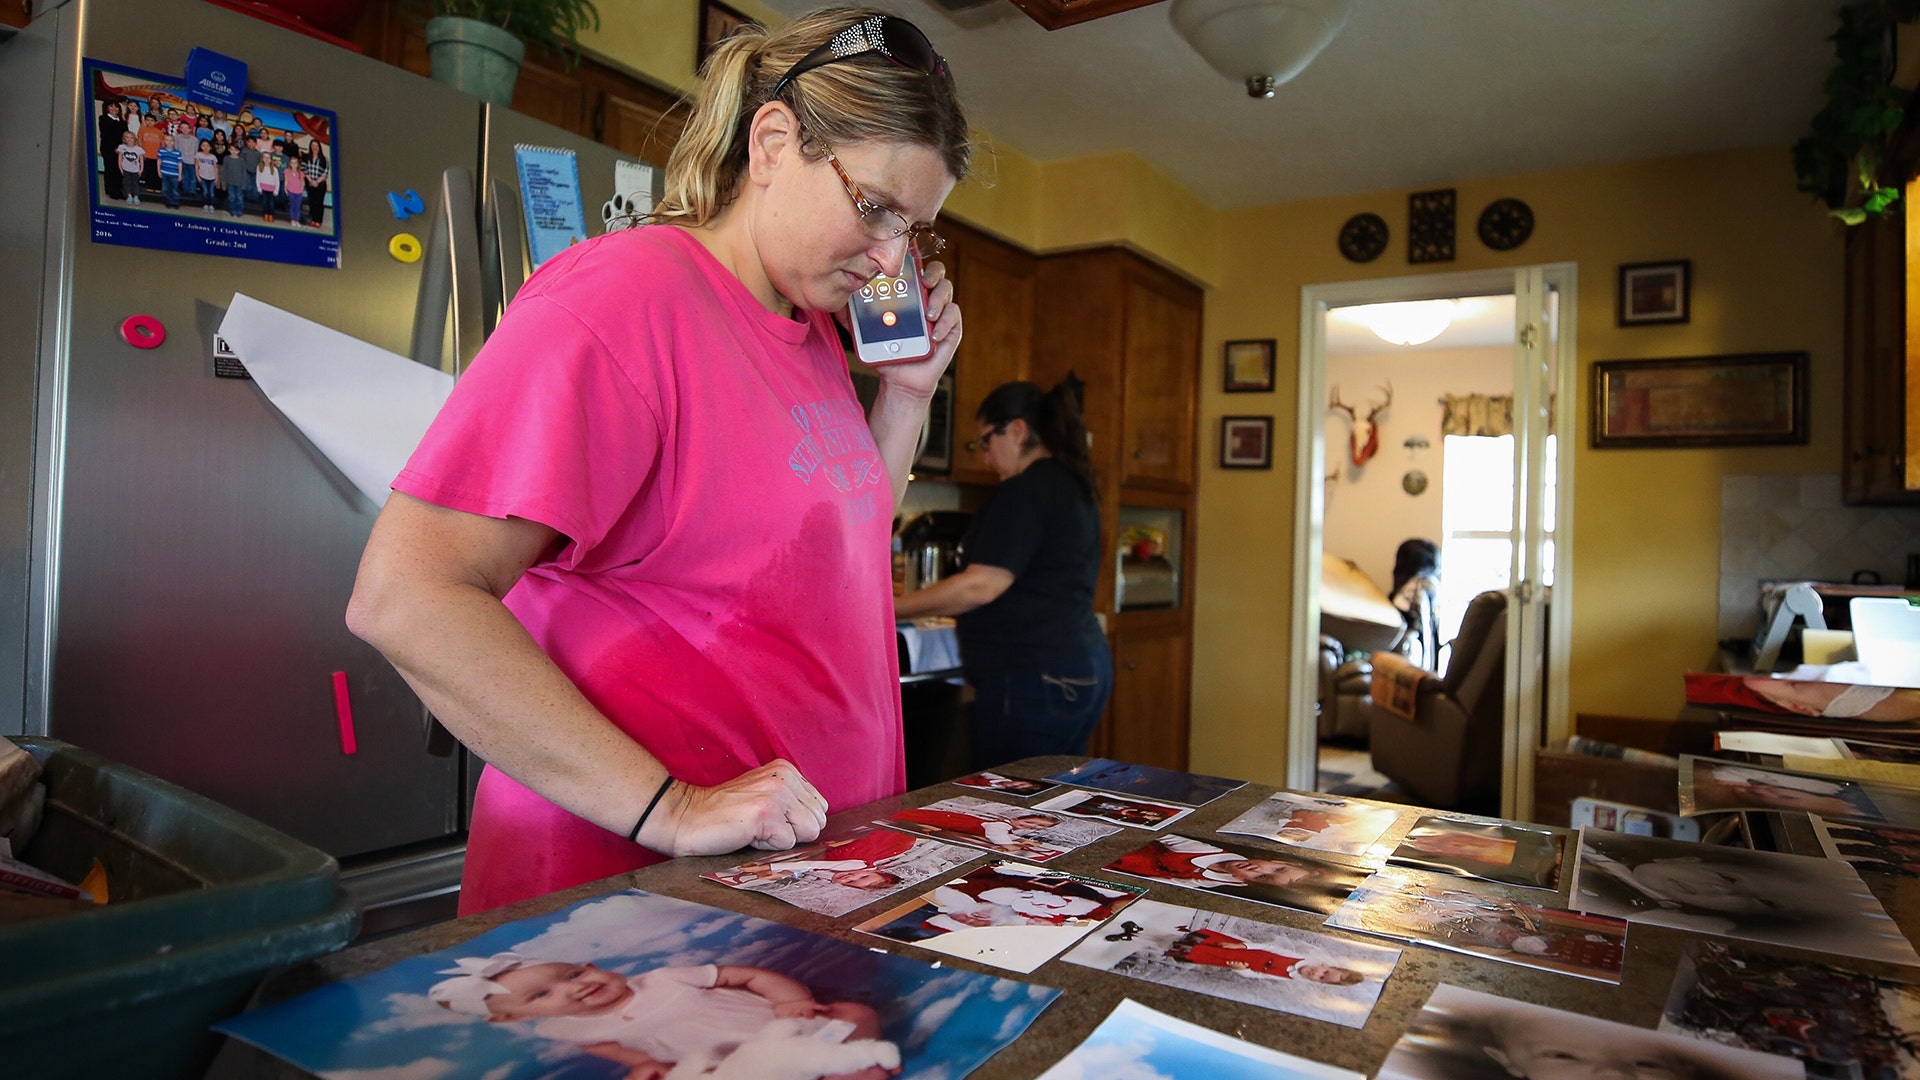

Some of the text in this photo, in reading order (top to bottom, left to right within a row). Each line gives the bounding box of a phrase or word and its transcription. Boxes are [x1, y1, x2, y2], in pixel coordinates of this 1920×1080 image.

[199, 78, 232, 94] Allstate
[95, 229, 113, 238] 2016
[174, 221, 185, 229] Dr.
[187, 223, 210, 233] Johnny
[220, 227, 239, 236] Clark
[239, 229, 275, 241] Elementary
[205, 237, 247, 250] Grade: 2nd
